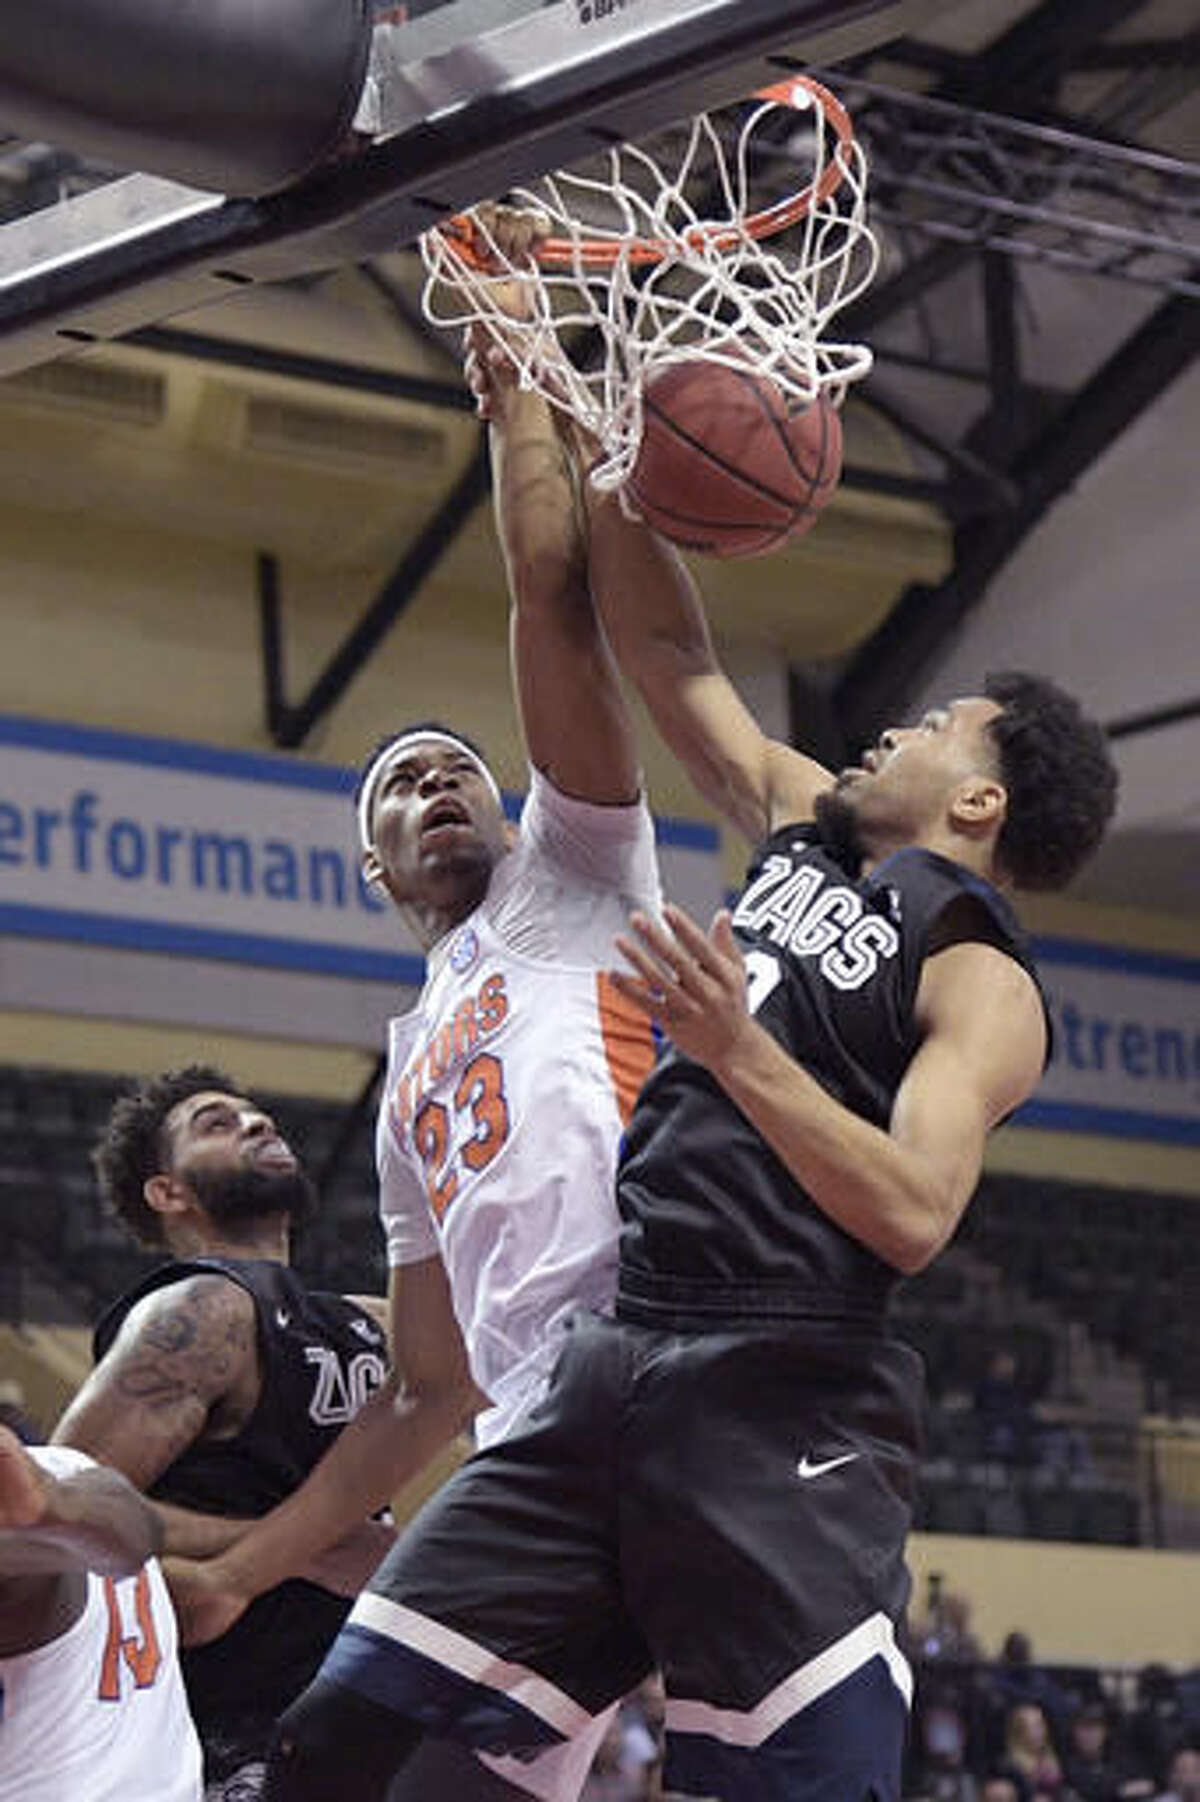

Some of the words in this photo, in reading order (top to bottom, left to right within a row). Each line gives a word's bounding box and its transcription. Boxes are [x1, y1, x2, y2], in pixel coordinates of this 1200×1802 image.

[732, 855, 899, 990] ZAGS
[1062, 1001, 1200, 1080] tren
[414, 1053, 510, 1229] 23
